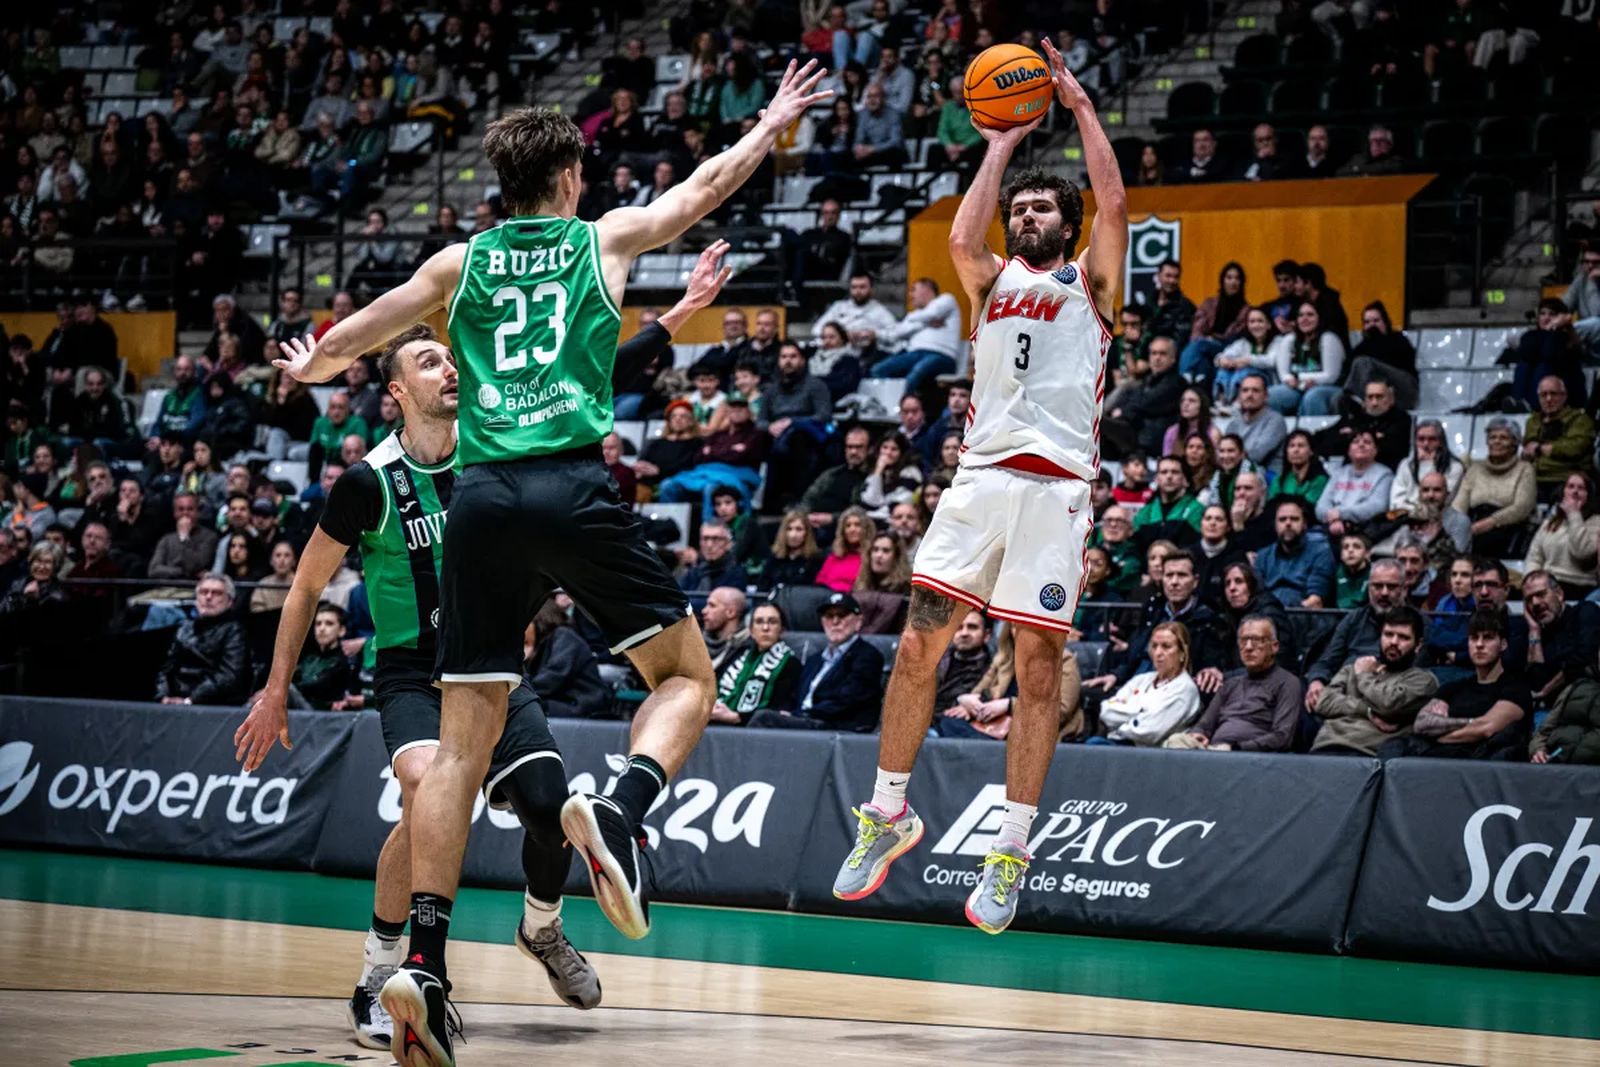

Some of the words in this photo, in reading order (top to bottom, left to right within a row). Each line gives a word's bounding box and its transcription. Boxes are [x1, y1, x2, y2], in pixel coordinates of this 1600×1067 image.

[993, 67, 1047, 90] Wilson
[487, 239, 574, 276] RUŽIĆ
[986, 288, 1068, 324] ELAN
[493, 281, 567, 372] 23
[1015, 332, 1031, 371] 3
[504, 382, 527, 395] City
[529, 377, 540, 390] of
[505, 381, 579, 411] BADALONA
[48, 764, 298, 834] oxperta
[1059, 799, 1129, 817] GRUPO
[1027, 812, 1217, 870] PACC
[1427, 804, 1600, 915] Sch
[1029, 871, 1058, 892] de
[1060, 873, 1151, 901] Seguros
